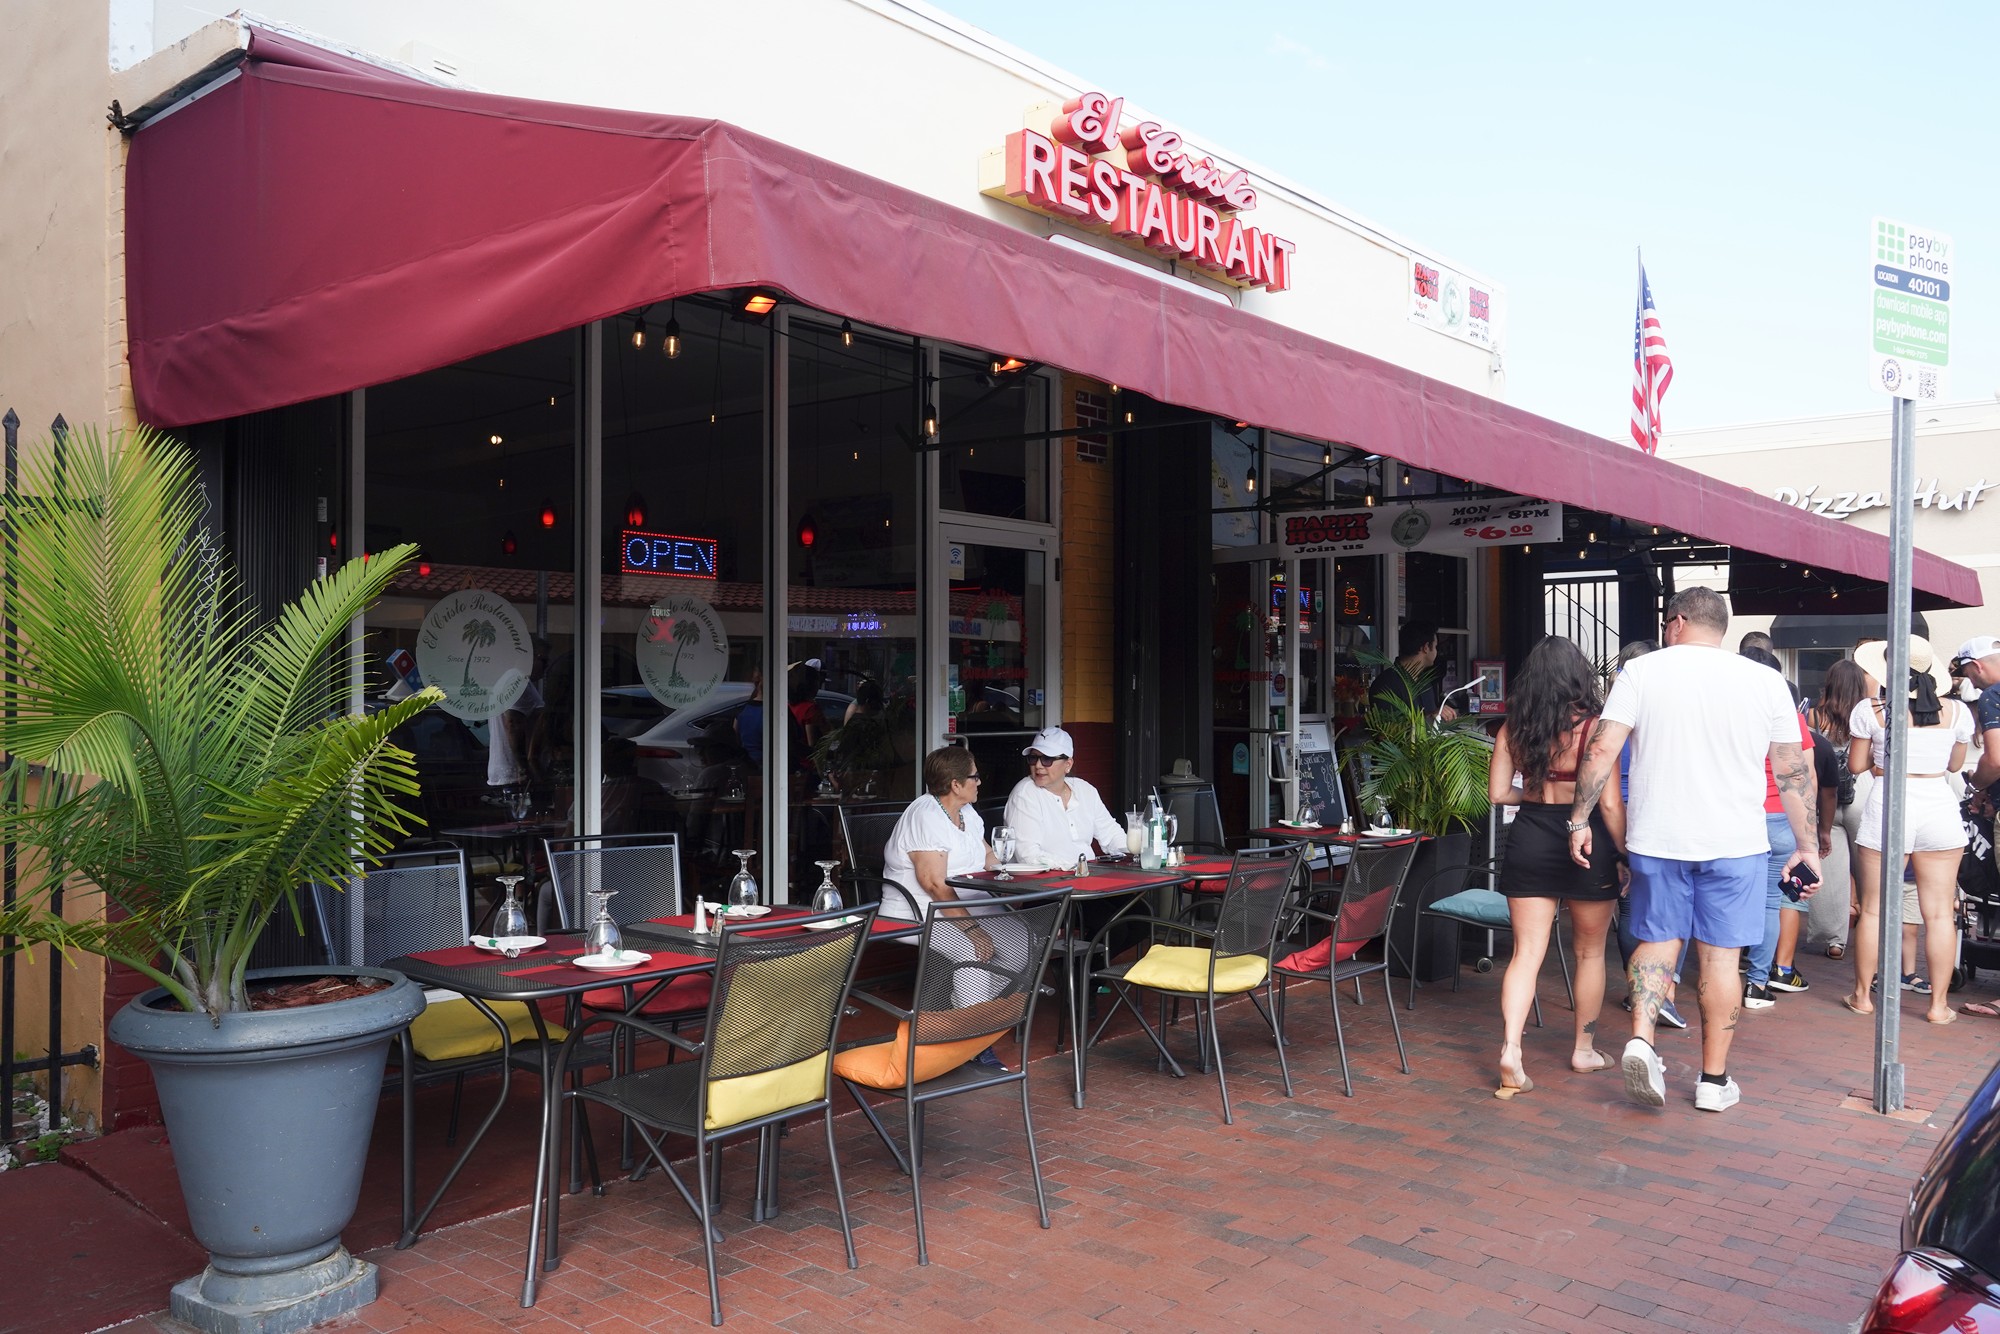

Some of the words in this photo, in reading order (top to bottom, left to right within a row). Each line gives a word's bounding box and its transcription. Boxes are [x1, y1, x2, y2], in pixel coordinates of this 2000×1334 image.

[1066, 92, 1124, 151] El
[1134, 121, 1258, 211] Cristo
[1020, 129, 1296, 293] RESTAURANT
[1909, 252, 1949, 275] phone
[1877, 270, 1899, 284] LOCATION
[1908, 277, 1941, 298] 40101
[1876, 292, 1910, 315] download
[1911, 303, 1933, 321] mobile
[1934, 311, 1948, 327] app
[1876, 316, 1947, 345] paybyphone.com
[1452, 505, 1491, 516] MON
[1774, 485, 1887, 519] Pizza
[1913, 477, 2000, 511] Hut
[1286, 513, 1373, 531] HAPPY
[1449, 516, 1487, 526] 4PM
[1508, 509, 1550, 519] 8PM
[1286, 527, 1370, 545] HOUR
[1294, 545, 1336, 554] Join
[1342, 543, 1364, 551] us
[626, 538, 714, 573] OPEN
[430, 598, 467, 629] Cristo
[470, 593, 528, 654] Restaurant
[651, 608, 672, 617] EQUIS
[681, 598, 727, 654] Restaurant
[422, 629, 439, 650] El
[447, 655, 464, 663] Since
[474, 656, 491, 664] 1972
[467, 701, 497, 714] Cuban
